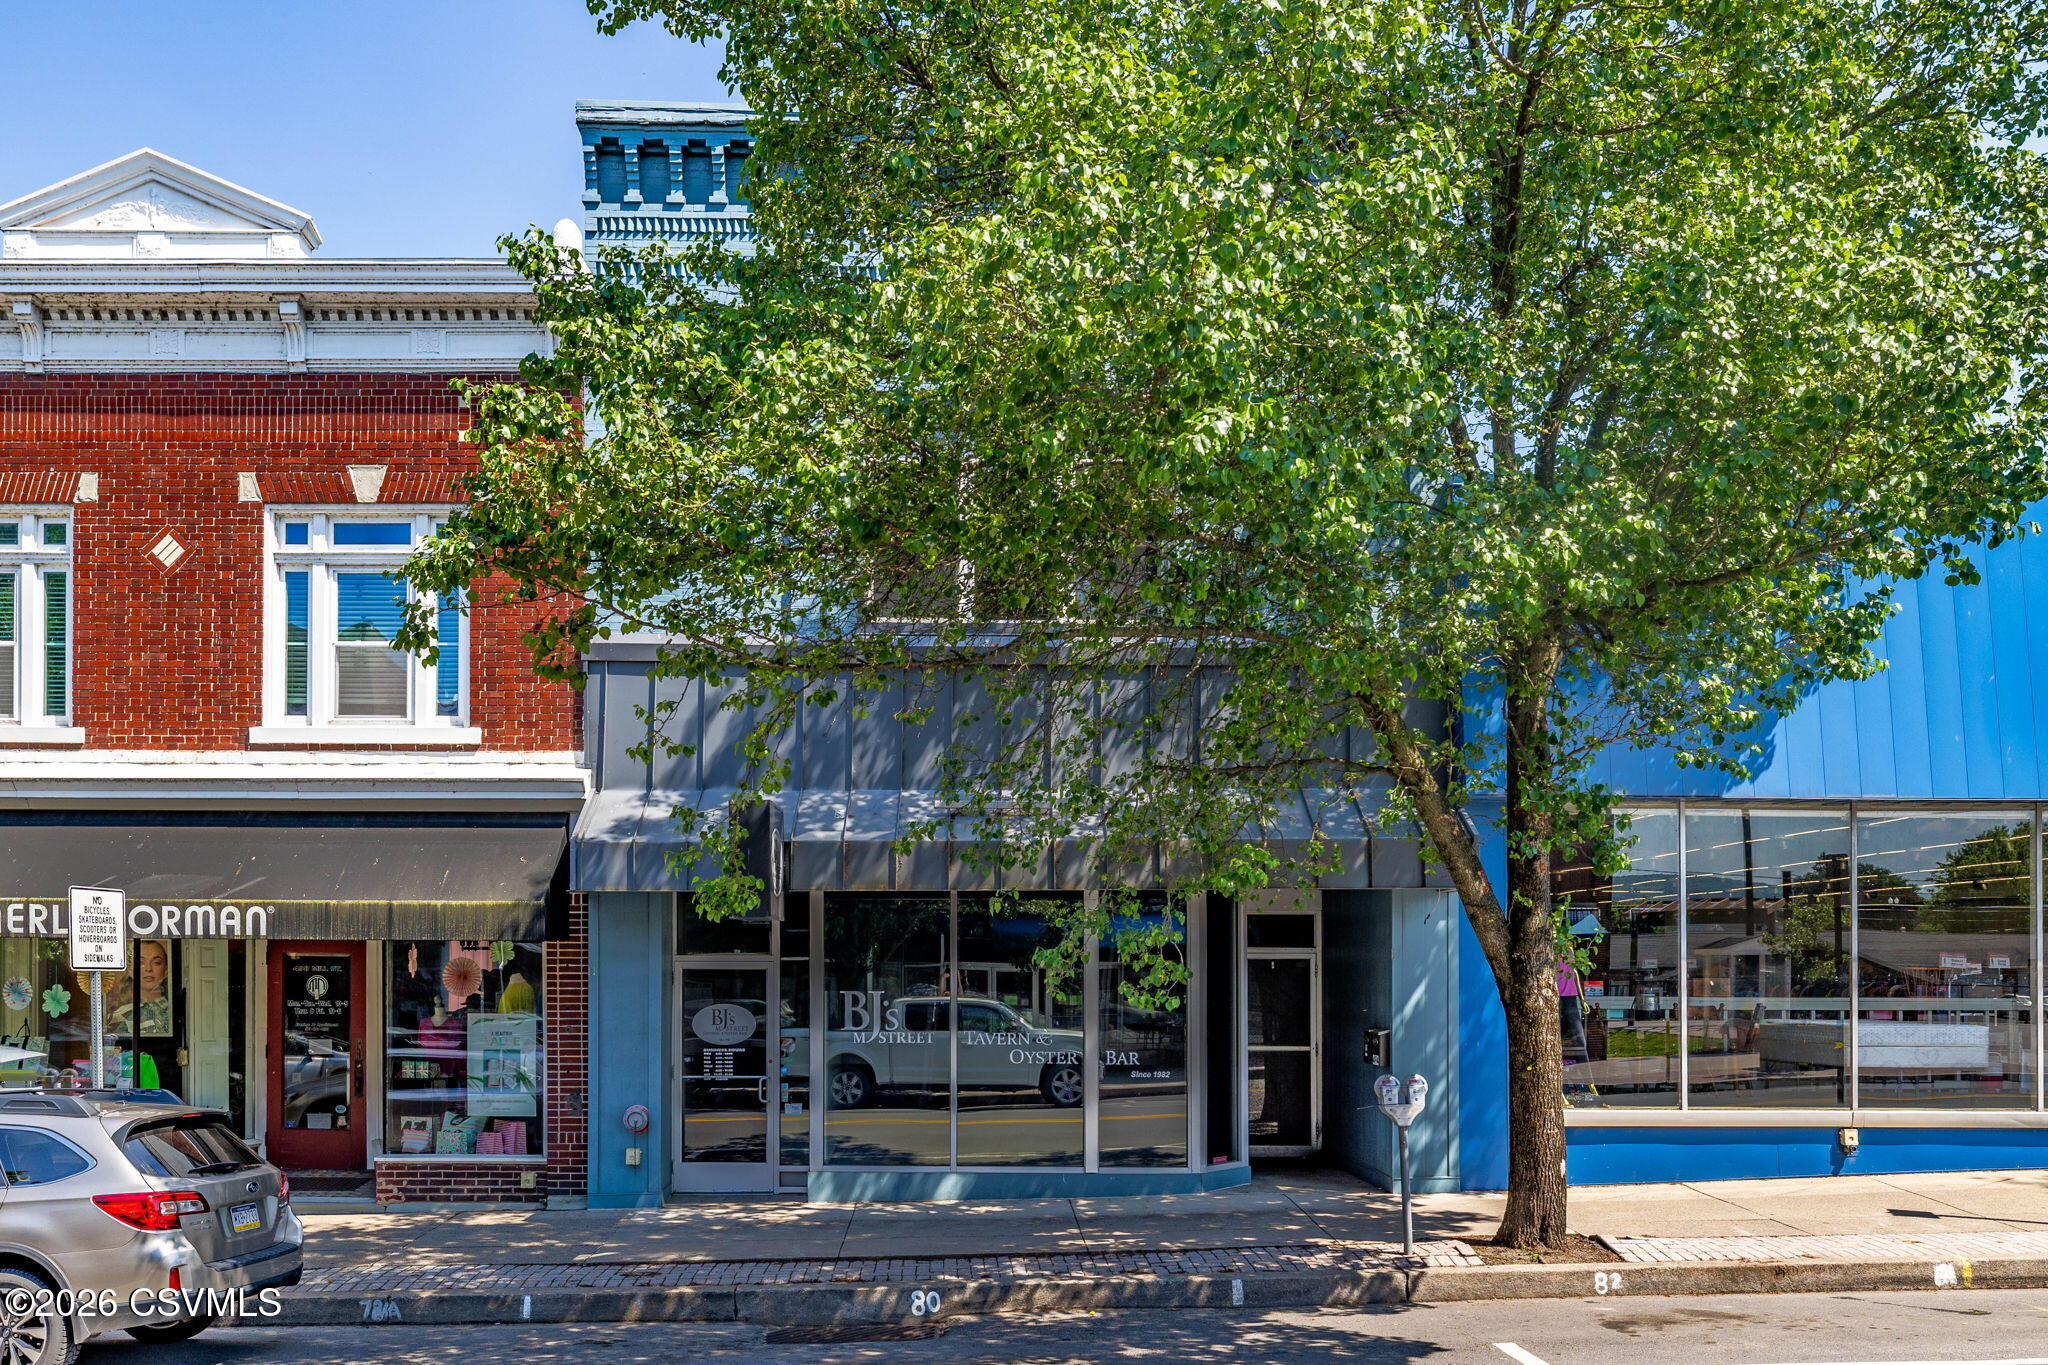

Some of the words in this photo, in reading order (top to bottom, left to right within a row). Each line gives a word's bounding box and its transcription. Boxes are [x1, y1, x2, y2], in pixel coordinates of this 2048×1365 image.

[92, 896, 102, 905] NO
[79, 925, 107, 934] SCOOTERS
[109, 926, 117, 934] OR
[79, 935, 118, 944] HOVERBOARDS
[94, 945, 103, 953] ON
[84, 954, 114, 963] SIDEWALKS
[711, 1008, 736, 1030] BJ's
[839, 990, 899, 1043] BJ's
[852, 1032, 866, 1044] M
[878, 1032, 935, 1044] STREET
[962, 1030, 1031, 1046] TAVERN
[1035, 1031, 1053, 1046] &
[1009, 1049, 1080, 1065] OYSTER
[1105, 1050, 1140, 1066] BAR
[1131, 1070, 1151, 1079] Since
[1152, 1070, 1171, 1079] 1982
[1594, 1271, 1623, 1295] 82
[911, 1290, 941, 1317] 80
